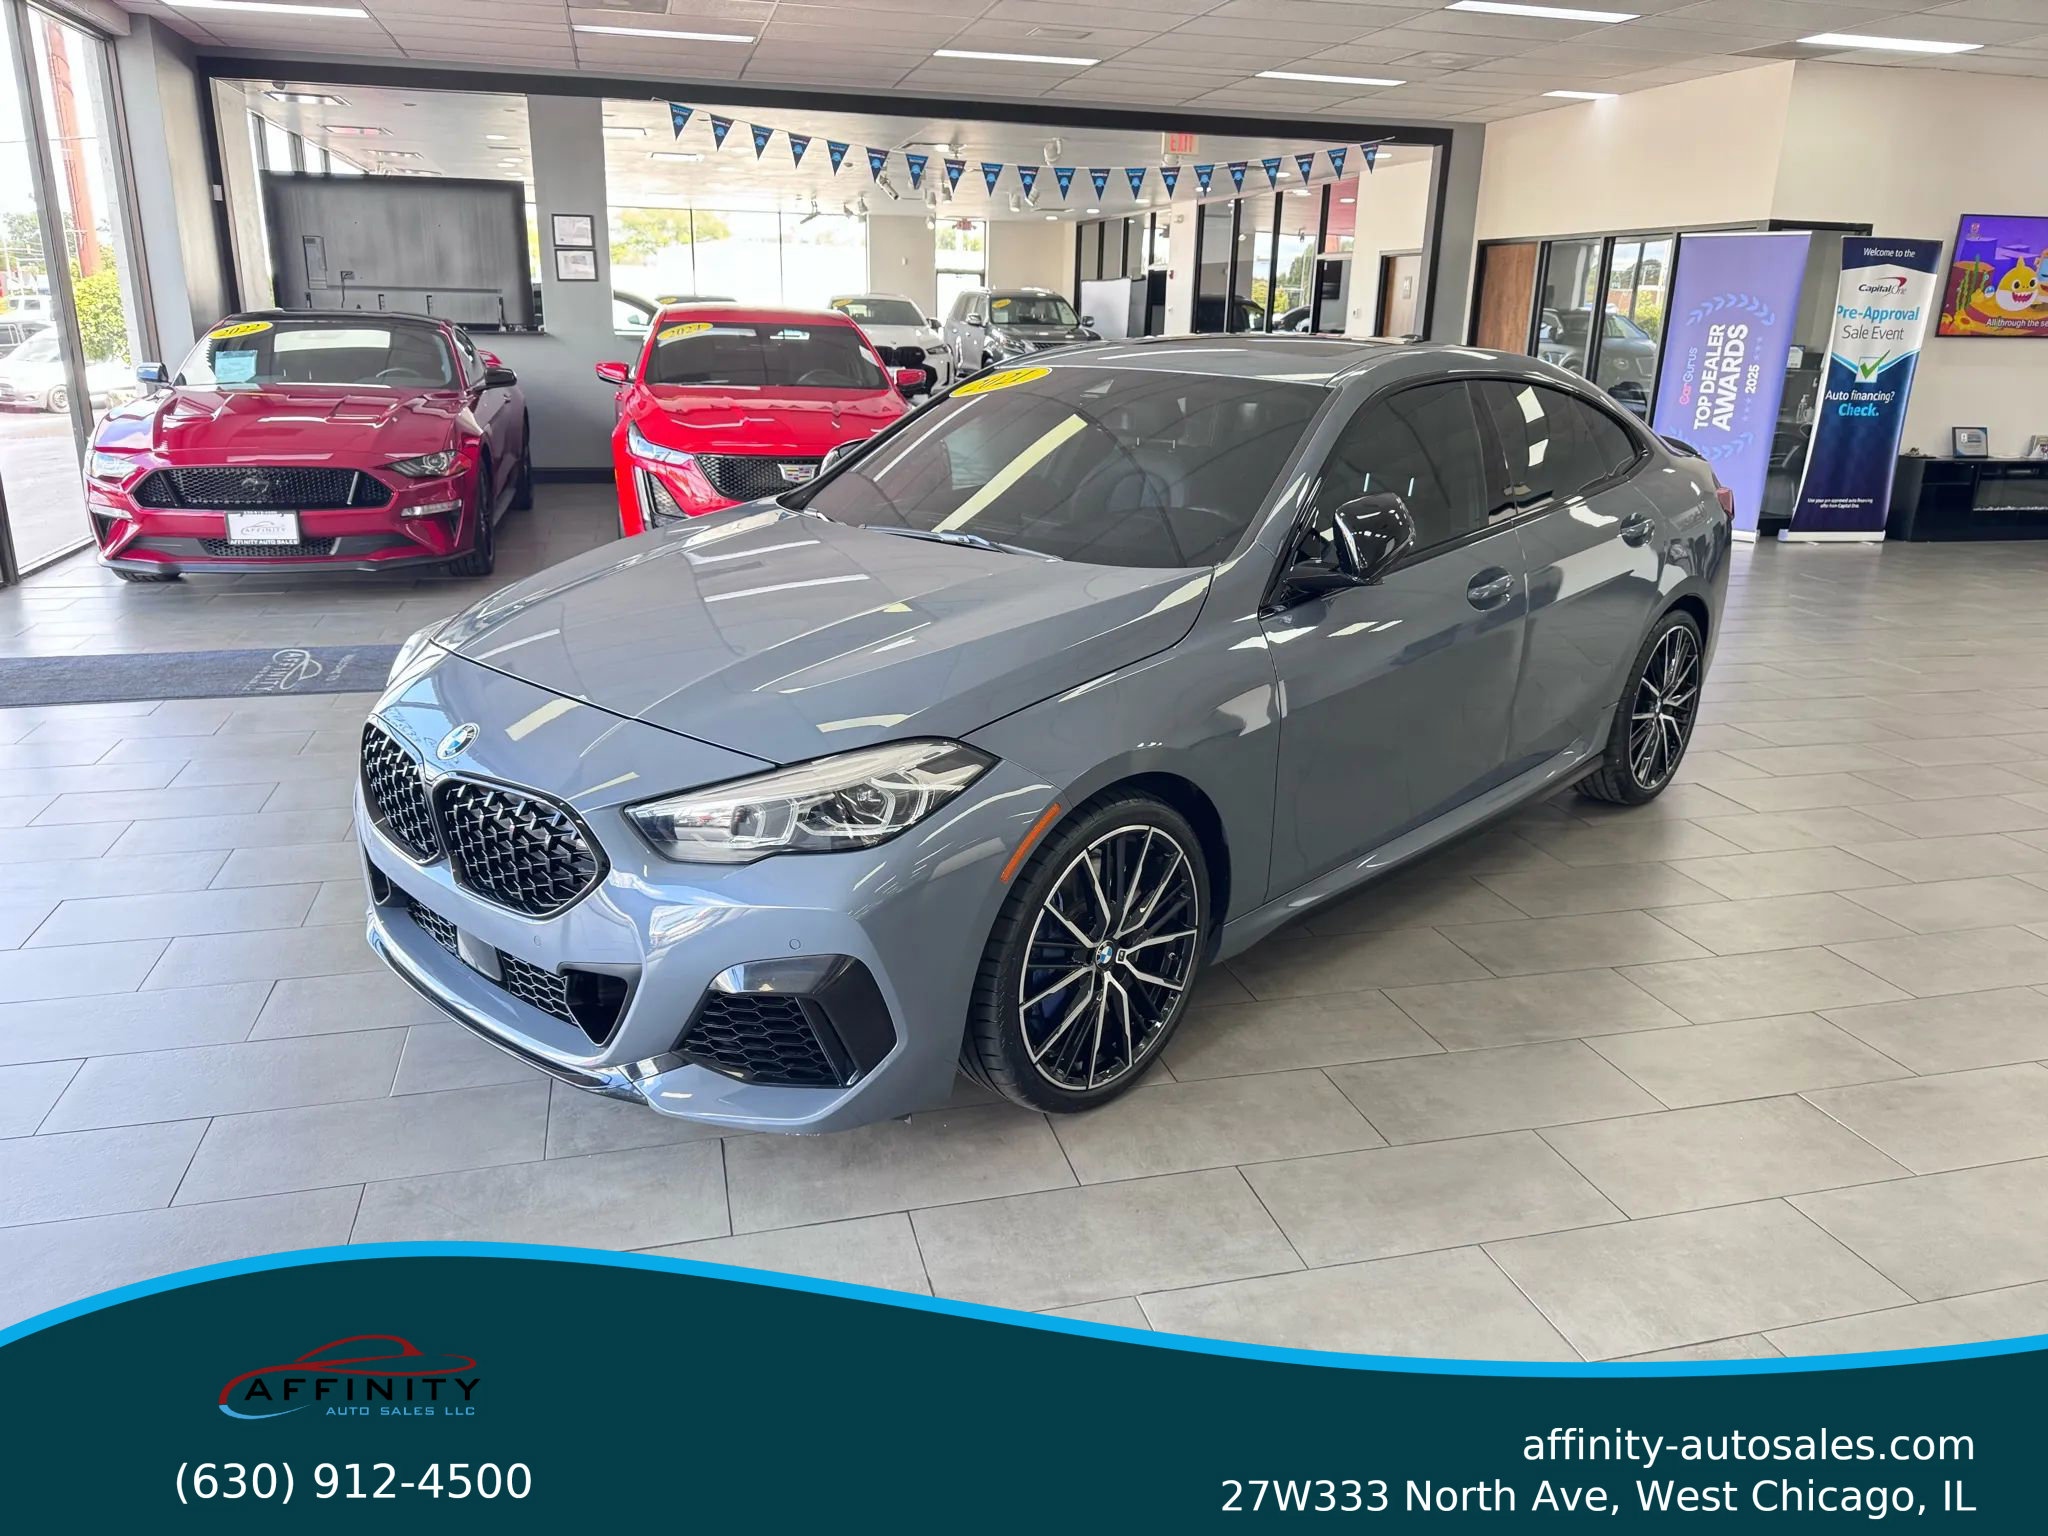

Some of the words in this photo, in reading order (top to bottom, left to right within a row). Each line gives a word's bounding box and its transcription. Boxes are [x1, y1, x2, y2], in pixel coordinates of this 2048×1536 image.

[1170, 133, 1193, 152] EXIT
[1863, 247, 1894, 257] Welcome
[1895, 249, 1903, 258] to
[1904, 249, 1916, 258] the
[1858, 284, 1891, 294] Capital
[1837, 305, 1920, 323] Pre-Approval
[1986, 318, 1997, 326] All
[1998, 318, 2025, 328] through
[2027, 318, 2039, 327] the
[1841, 325, 1869, 340] Sale
[1871, 326, 1905, 340] Event
[1700, 324, 1726, 393] DEALER
[1712, 324, 1749, 431] AWARDS
[1745, 364, 1760, 394] 2025
[1825, 390, 1850, 400] Auto
[1850, 390, 1896, 404] financing?
[1693, 396, 1713, 430] TOP
[1838, 403, 1880, 416] Check.
